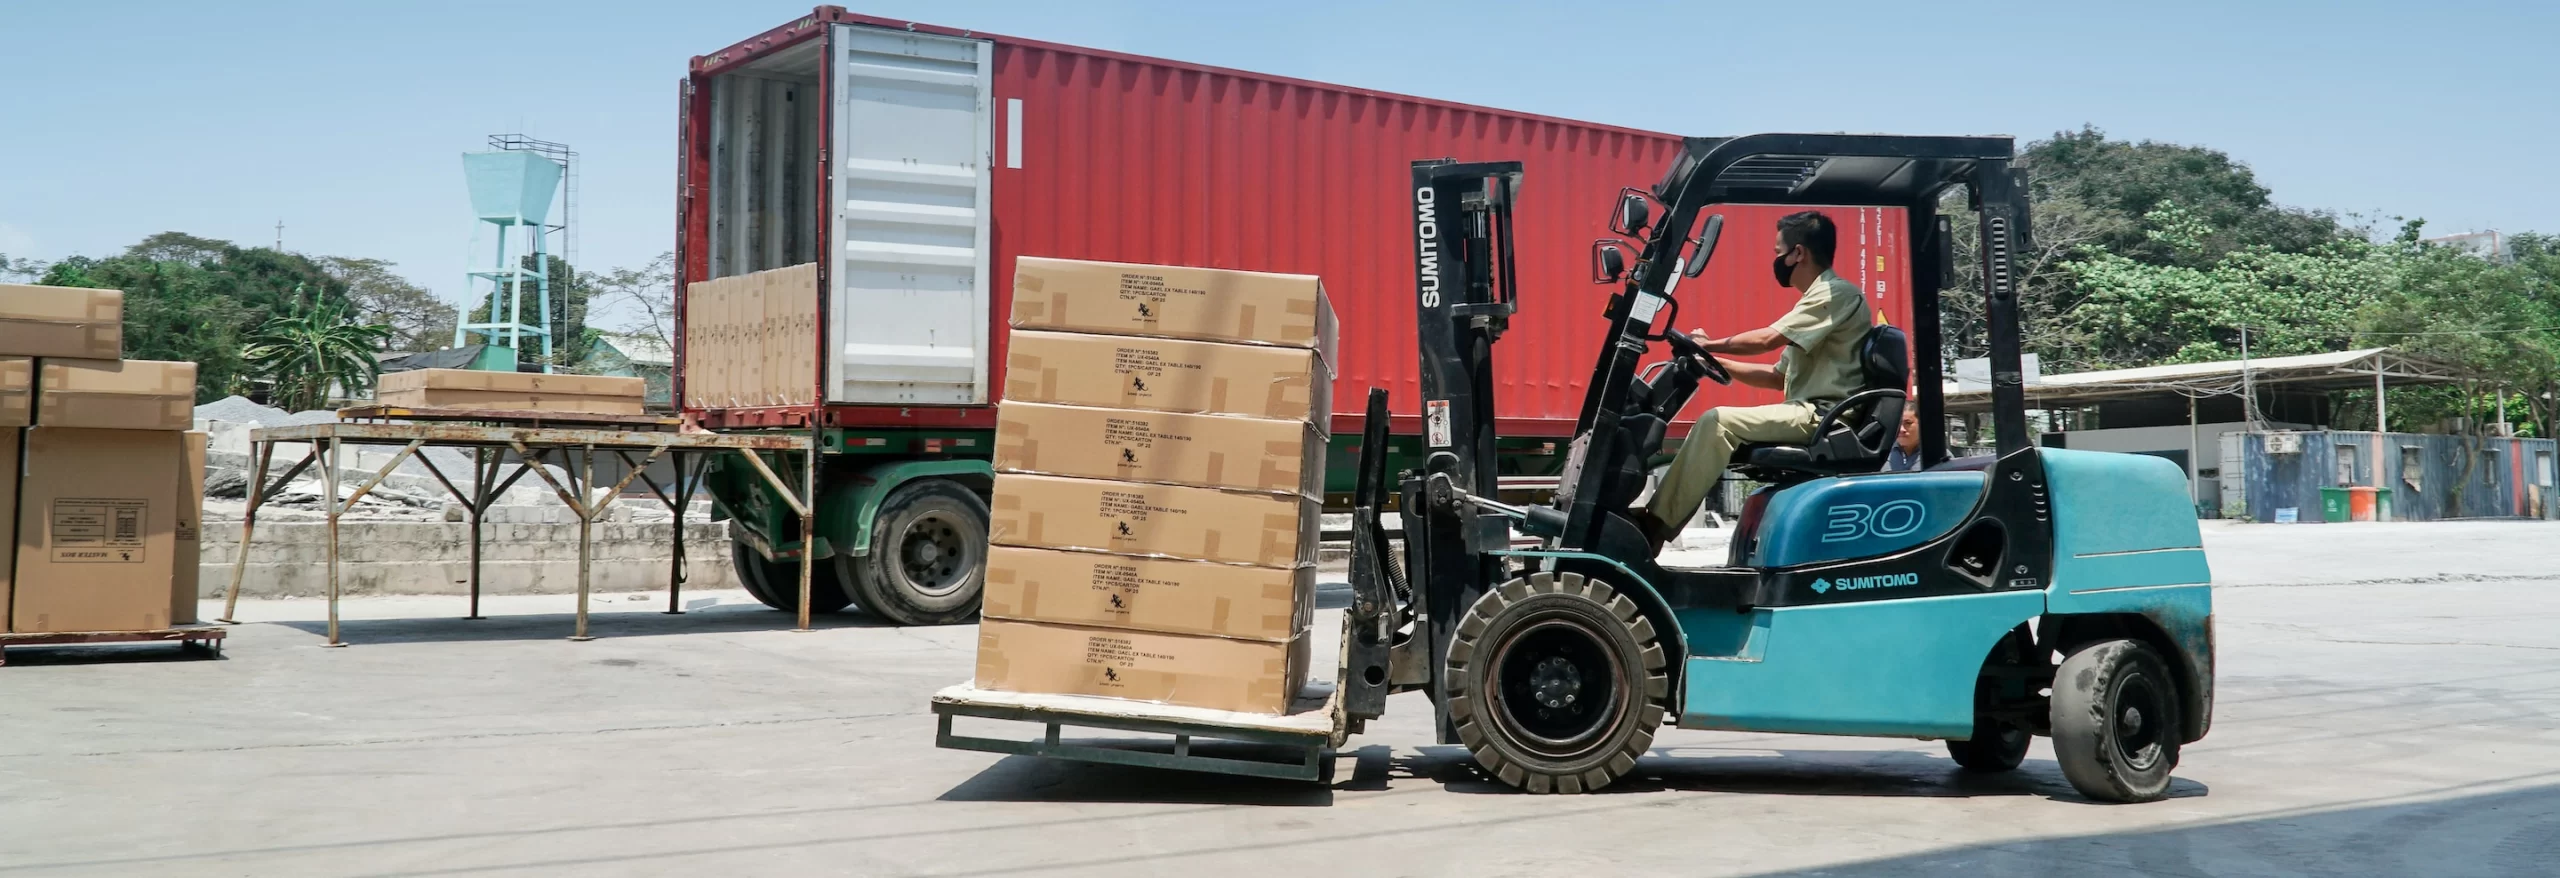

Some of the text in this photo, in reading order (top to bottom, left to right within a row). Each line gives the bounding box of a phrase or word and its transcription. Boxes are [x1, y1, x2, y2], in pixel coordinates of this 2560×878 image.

[1418, 186, 1439, 308] SUMITOMO
[1822, 499, 1926, 543] 30
[1835, 572, 1918, 591] SUMITOMO
